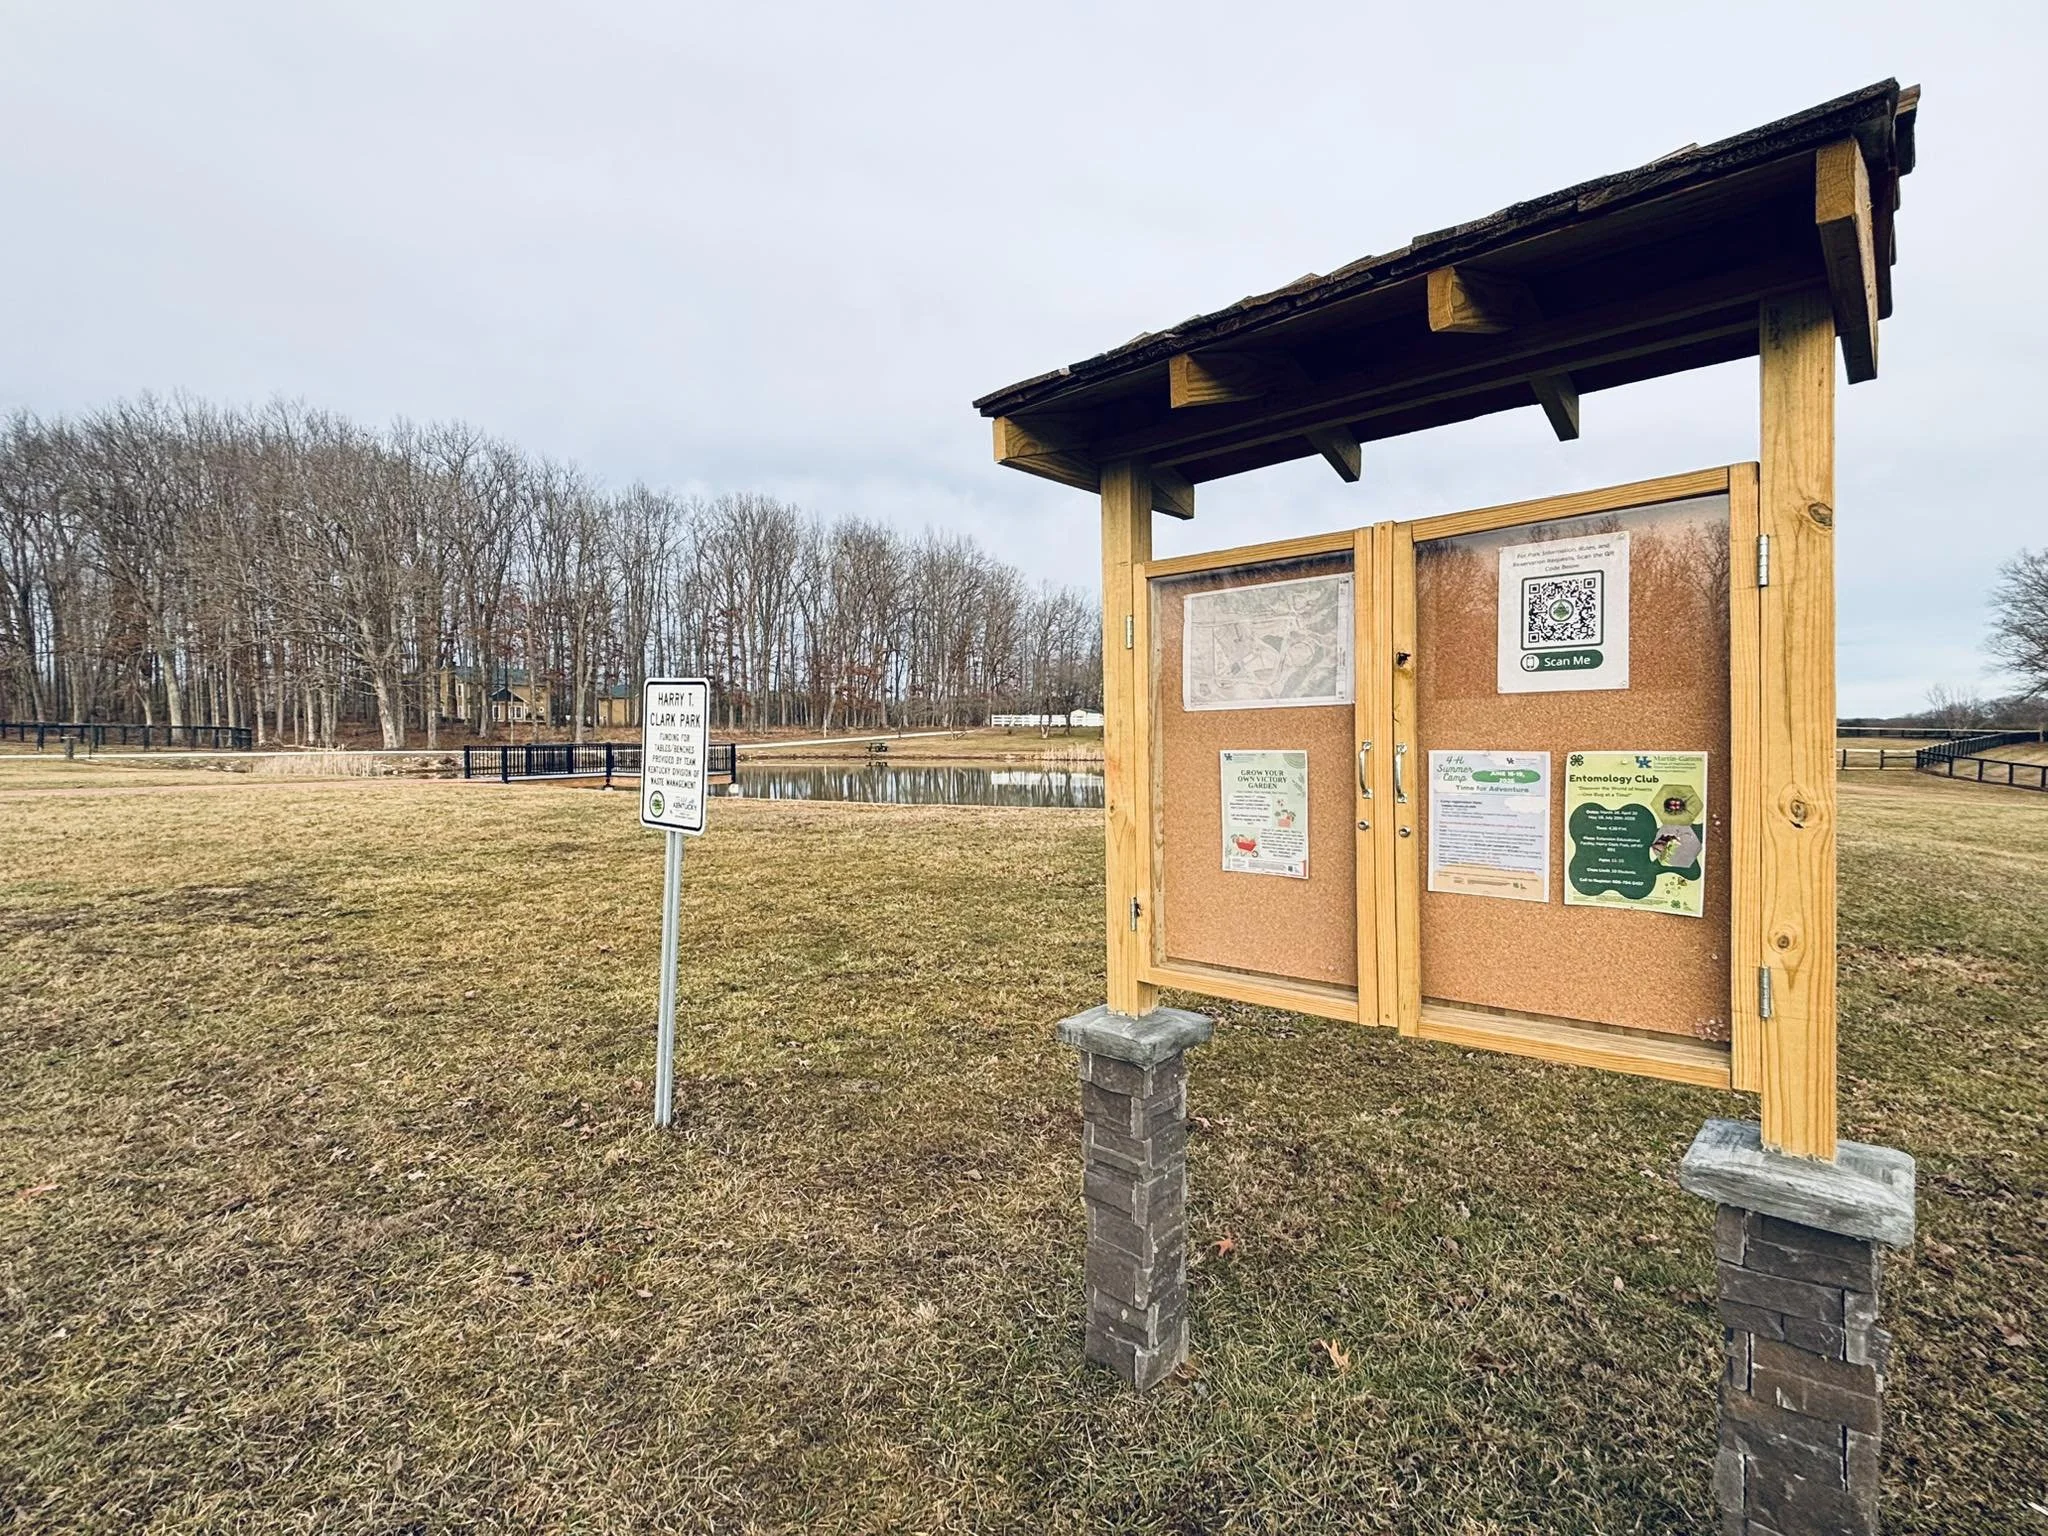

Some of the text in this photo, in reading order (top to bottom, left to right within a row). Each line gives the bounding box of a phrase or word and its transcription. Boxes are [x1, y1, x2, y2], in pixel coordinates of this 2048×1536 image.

[1544, 656, 1591, 668] Scan Me
[658, 692, 694, 707] HARRY T.
[650, 712, 701, 728] CLARK PARK
[660, 732, 690, 742] FUNDING FOR
[652, 754, 696, 766] PROVIDED BY TEAM
[648, 766, 700, 778] KENTUCKY DIVISION OF
[1437, 764, 1473, 774] Summer
[650, 777, 696, 789] WASTE MANAGEMENT
[1443, 773, 1468, 784] Camp
[1569, 774, 1660, 785] Entomology Club
[673, 802, 697, 810] KENTUCKY
